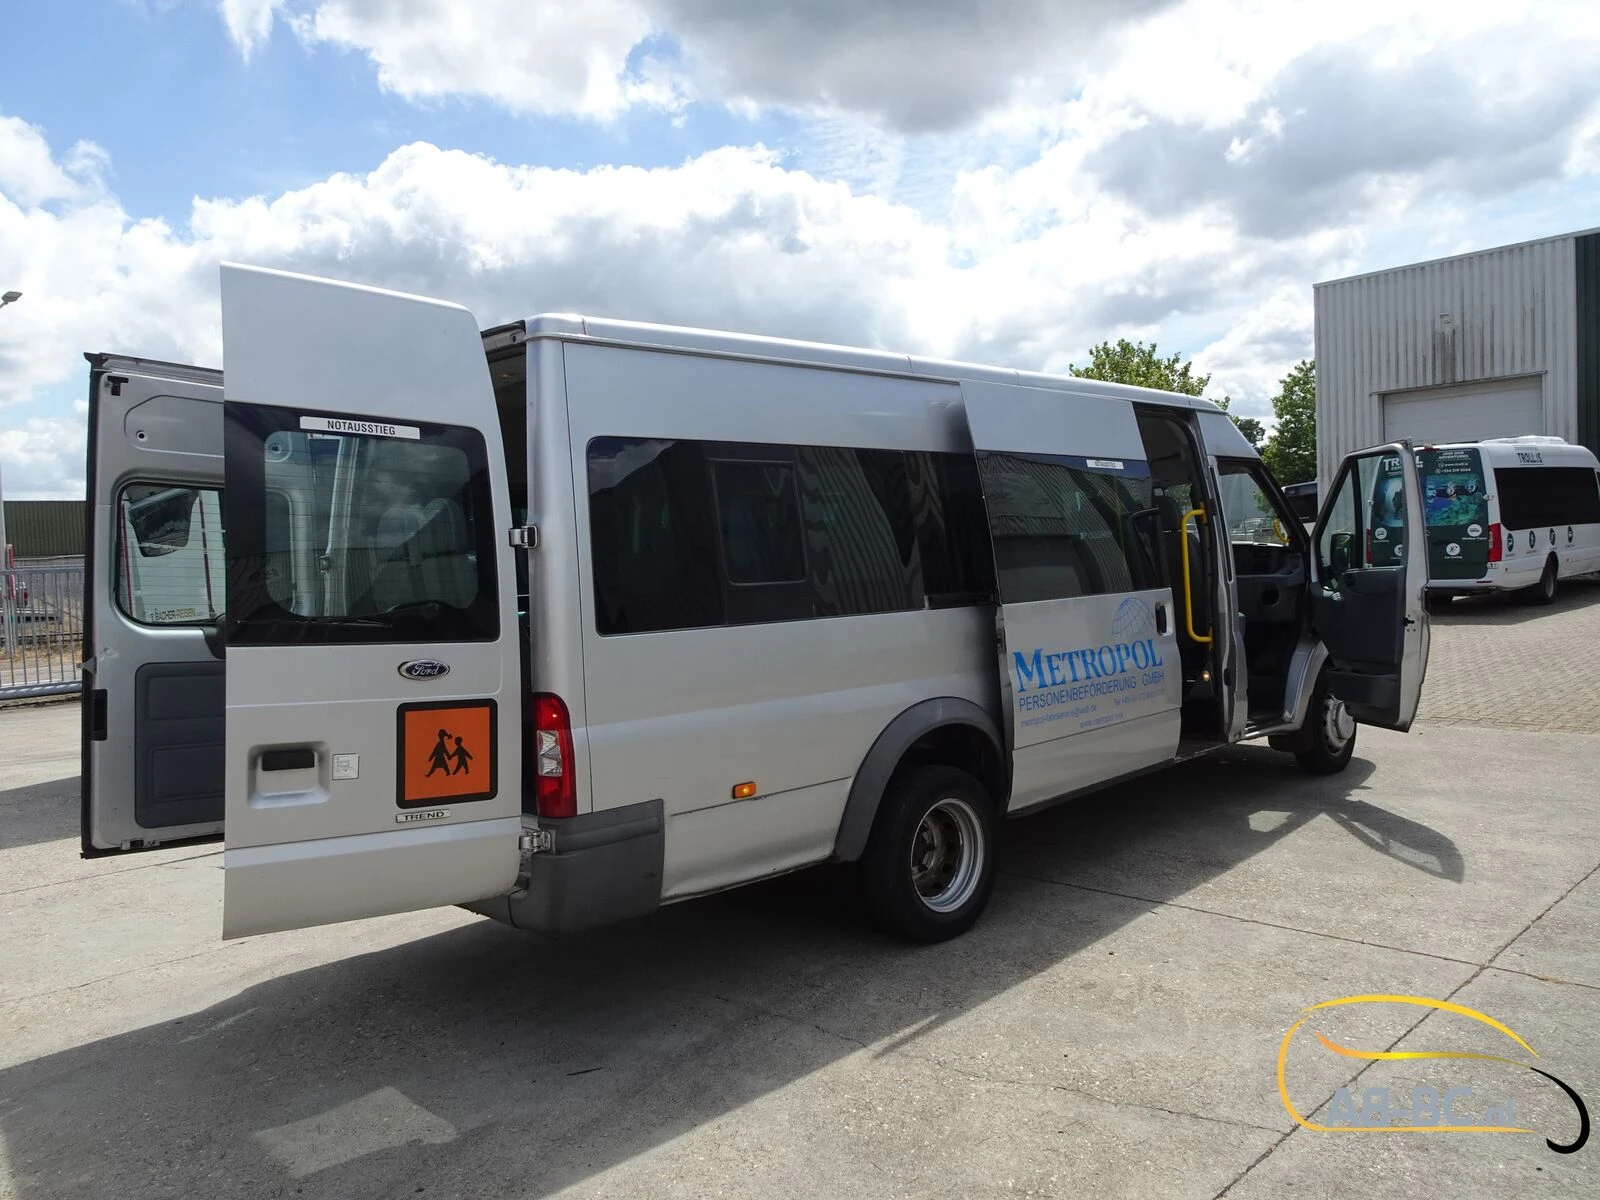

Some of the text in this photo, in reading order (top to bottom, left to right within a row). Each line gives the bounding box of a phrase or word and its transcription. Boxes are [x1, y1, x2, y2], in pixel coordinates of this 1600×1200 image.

[327, 420, 396, 436] NOTAUSSTIEG
[411, 662, 441, 677] Ford
[1013, 638, 1163, 693] METROPOL
[1142, 671, 1164, 687] GMBH
[403, 811, 445, 821] TREND
